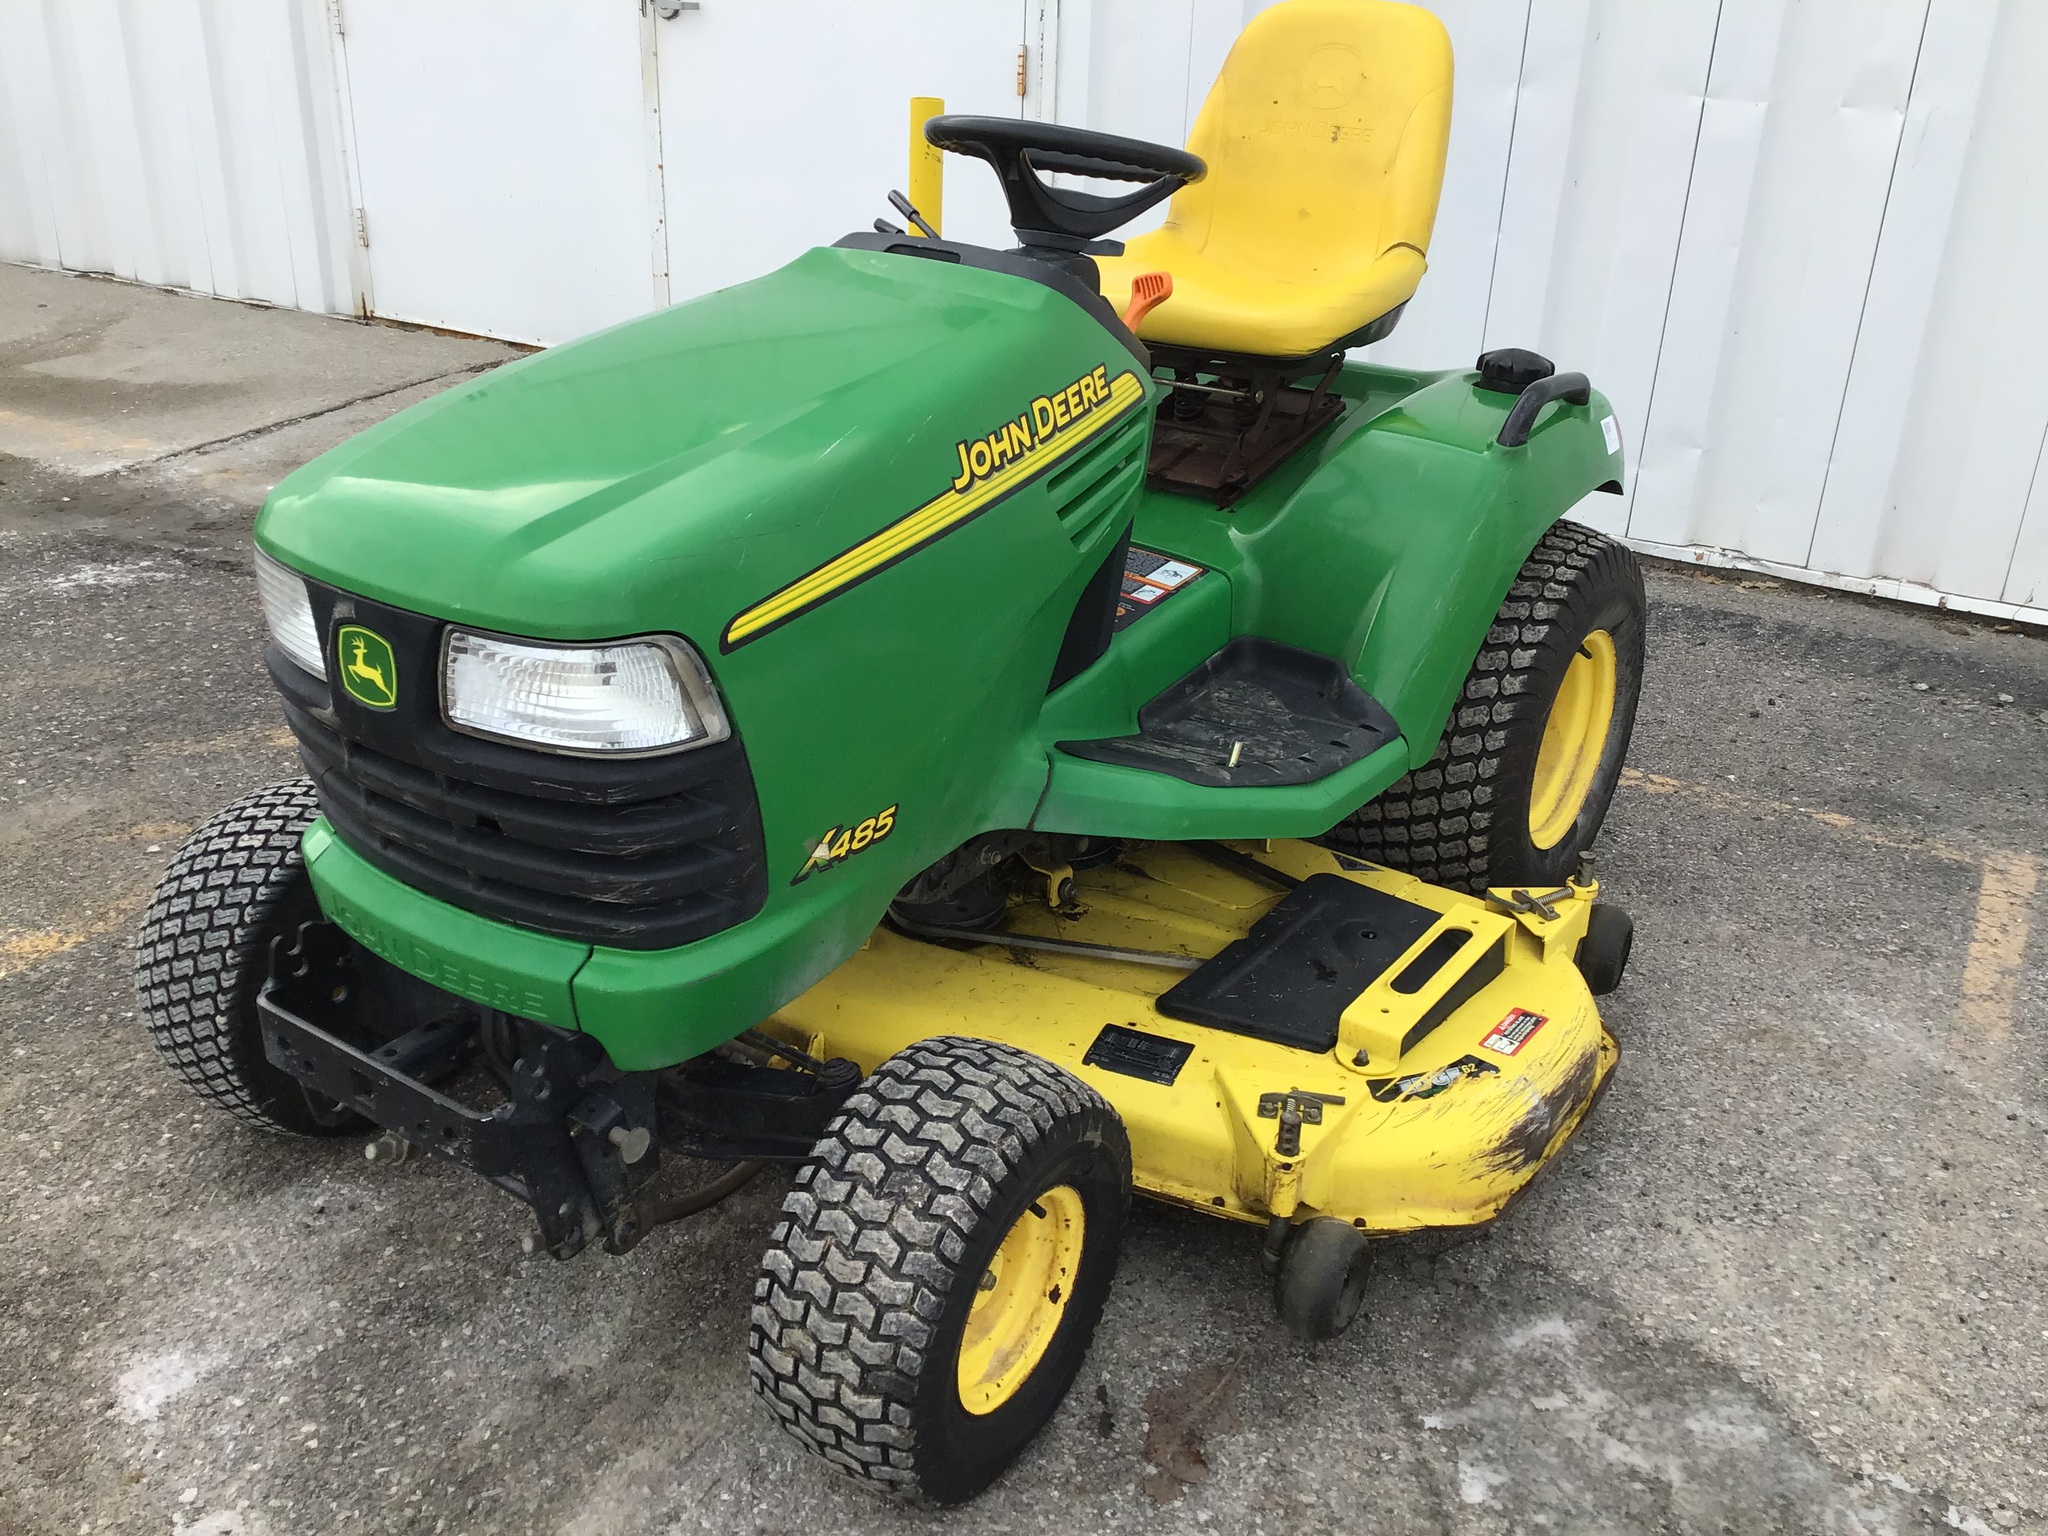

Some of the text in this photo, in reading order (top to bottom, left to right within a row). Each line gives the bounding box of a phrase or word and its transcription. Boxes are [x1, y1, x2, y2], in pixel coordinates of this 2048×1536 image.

[953, 363, 1112, 492] JOHN DEERE
[790, 803, 899, 886] X485
[330, 894, 548, 1018] JOHN DEERE
